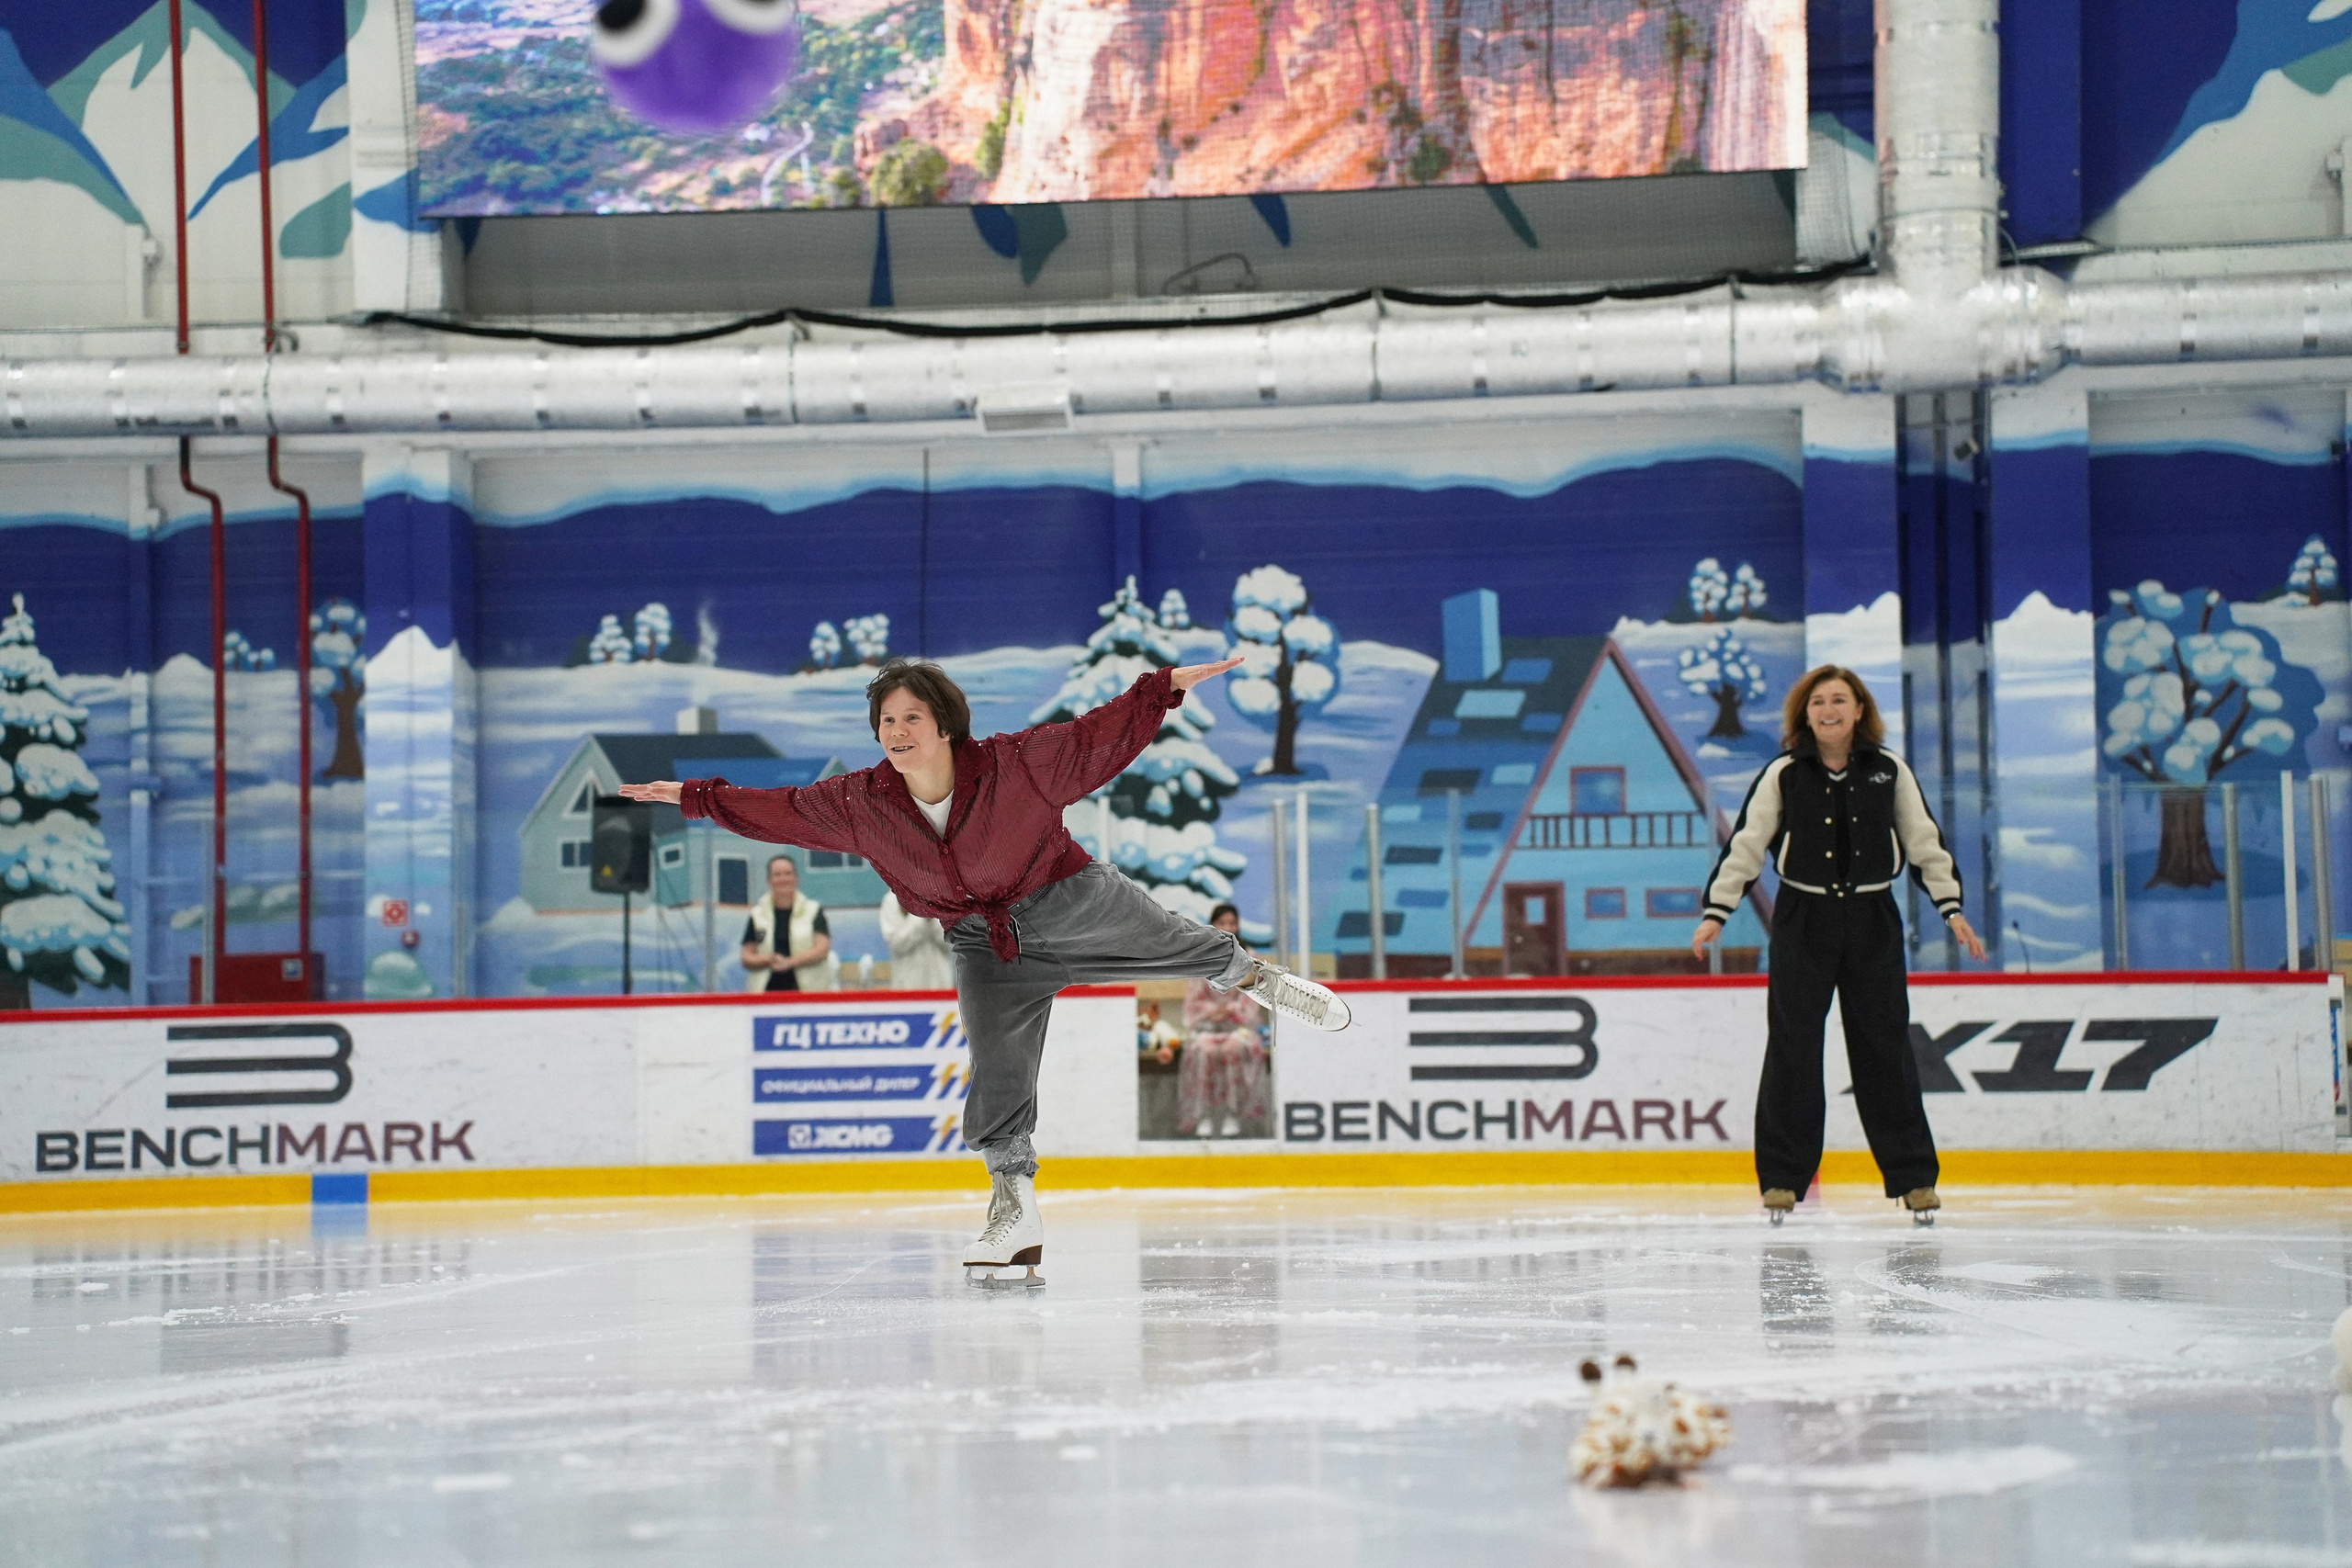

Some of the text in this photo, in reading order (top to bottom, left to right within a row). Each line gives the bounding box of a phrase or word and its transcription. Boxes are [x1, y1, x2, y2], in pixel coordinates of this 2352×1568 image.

[773, 1020, 910, 1048] ГЦ ТЕХНО
[1285, 1099, 1730, 1142] BENCHMARK
[36, 1120, 476, 1172] BENCHMARK
